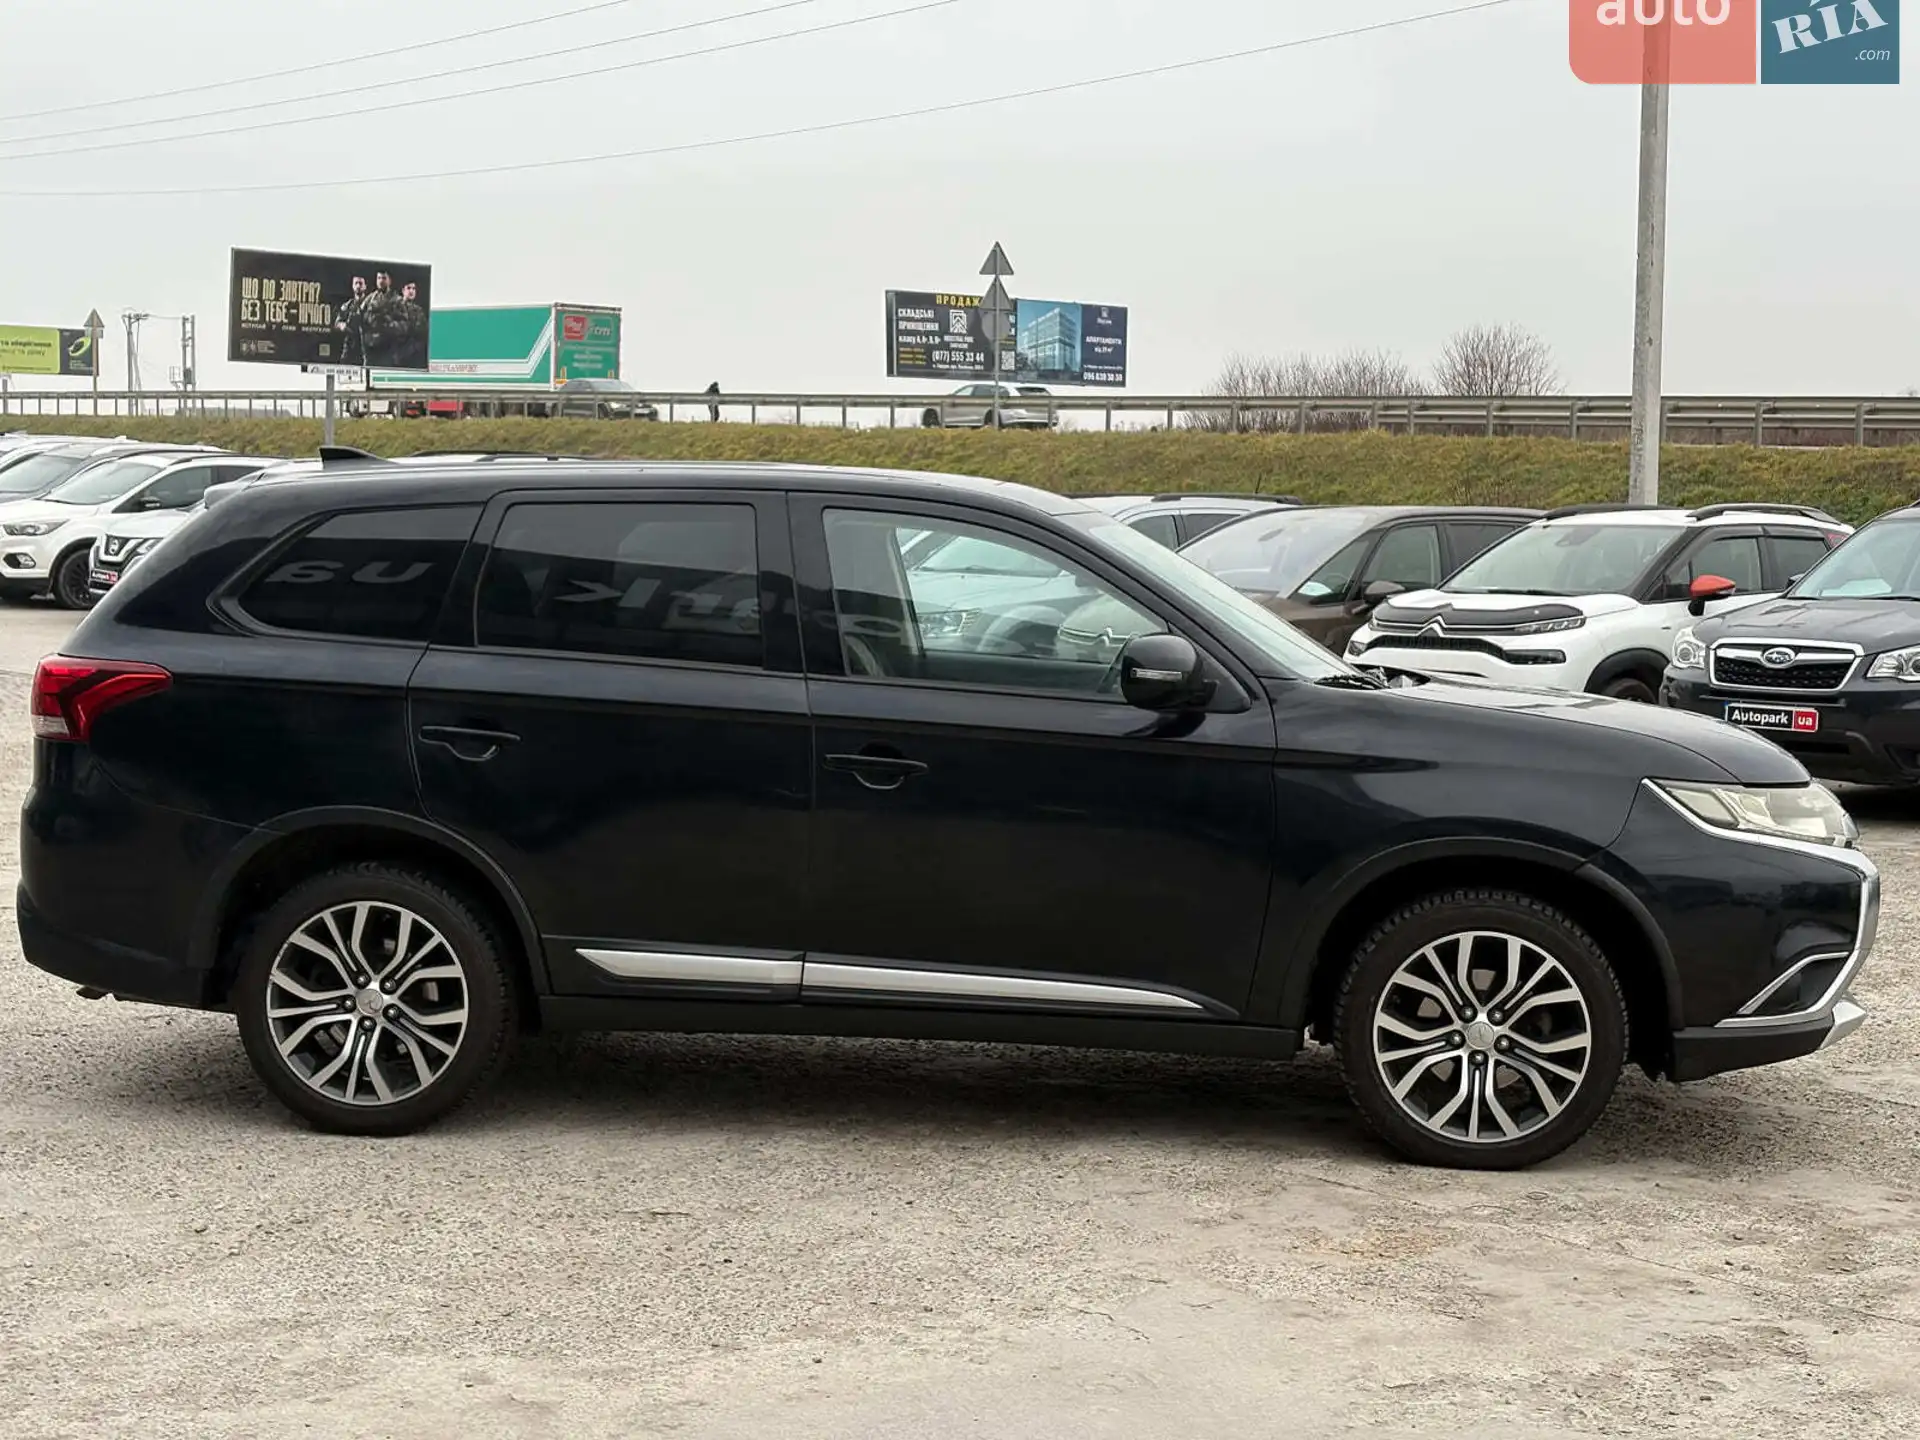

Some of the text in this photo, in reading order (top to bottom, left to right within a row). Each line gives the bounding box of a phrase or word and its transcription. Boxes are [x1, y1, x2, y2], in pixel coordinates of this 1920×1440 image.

[241, 298, 260, 322] БЕЗ
[264, 300, 288, 323] ТЕБЕ
[951, 351, 965, 362] 555
[1731, 707, 1813, 727] Autopark ua
